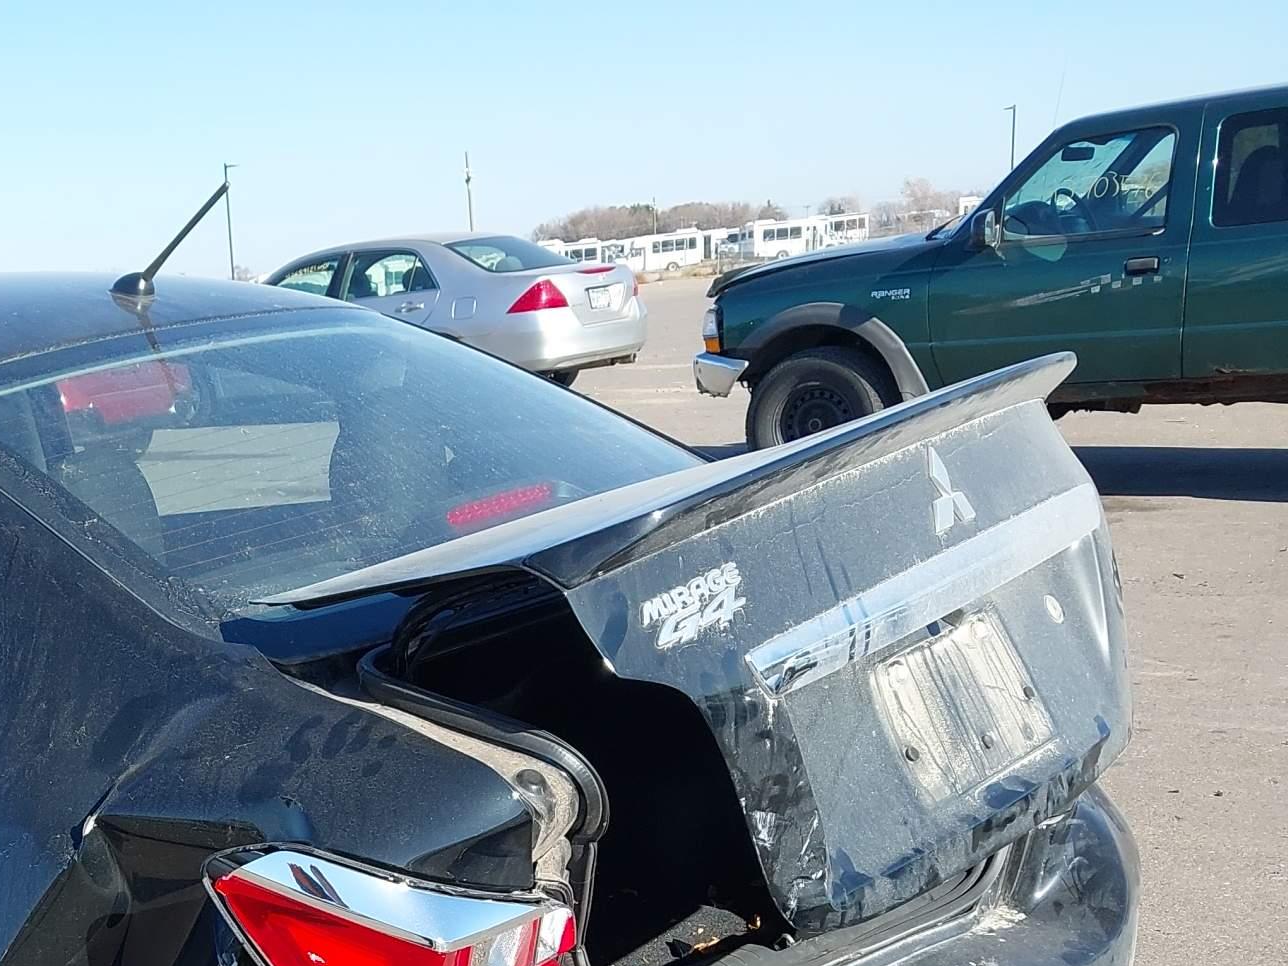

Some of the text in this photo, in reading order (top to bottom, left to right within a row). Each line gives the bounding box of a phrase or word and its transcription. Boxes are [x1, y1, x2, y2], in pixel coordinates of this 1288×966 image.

[870, 288, 911, 299] RANGER
[640, 561, 742, 629] MIRAGE
[655, 585, 746, 649] G4
